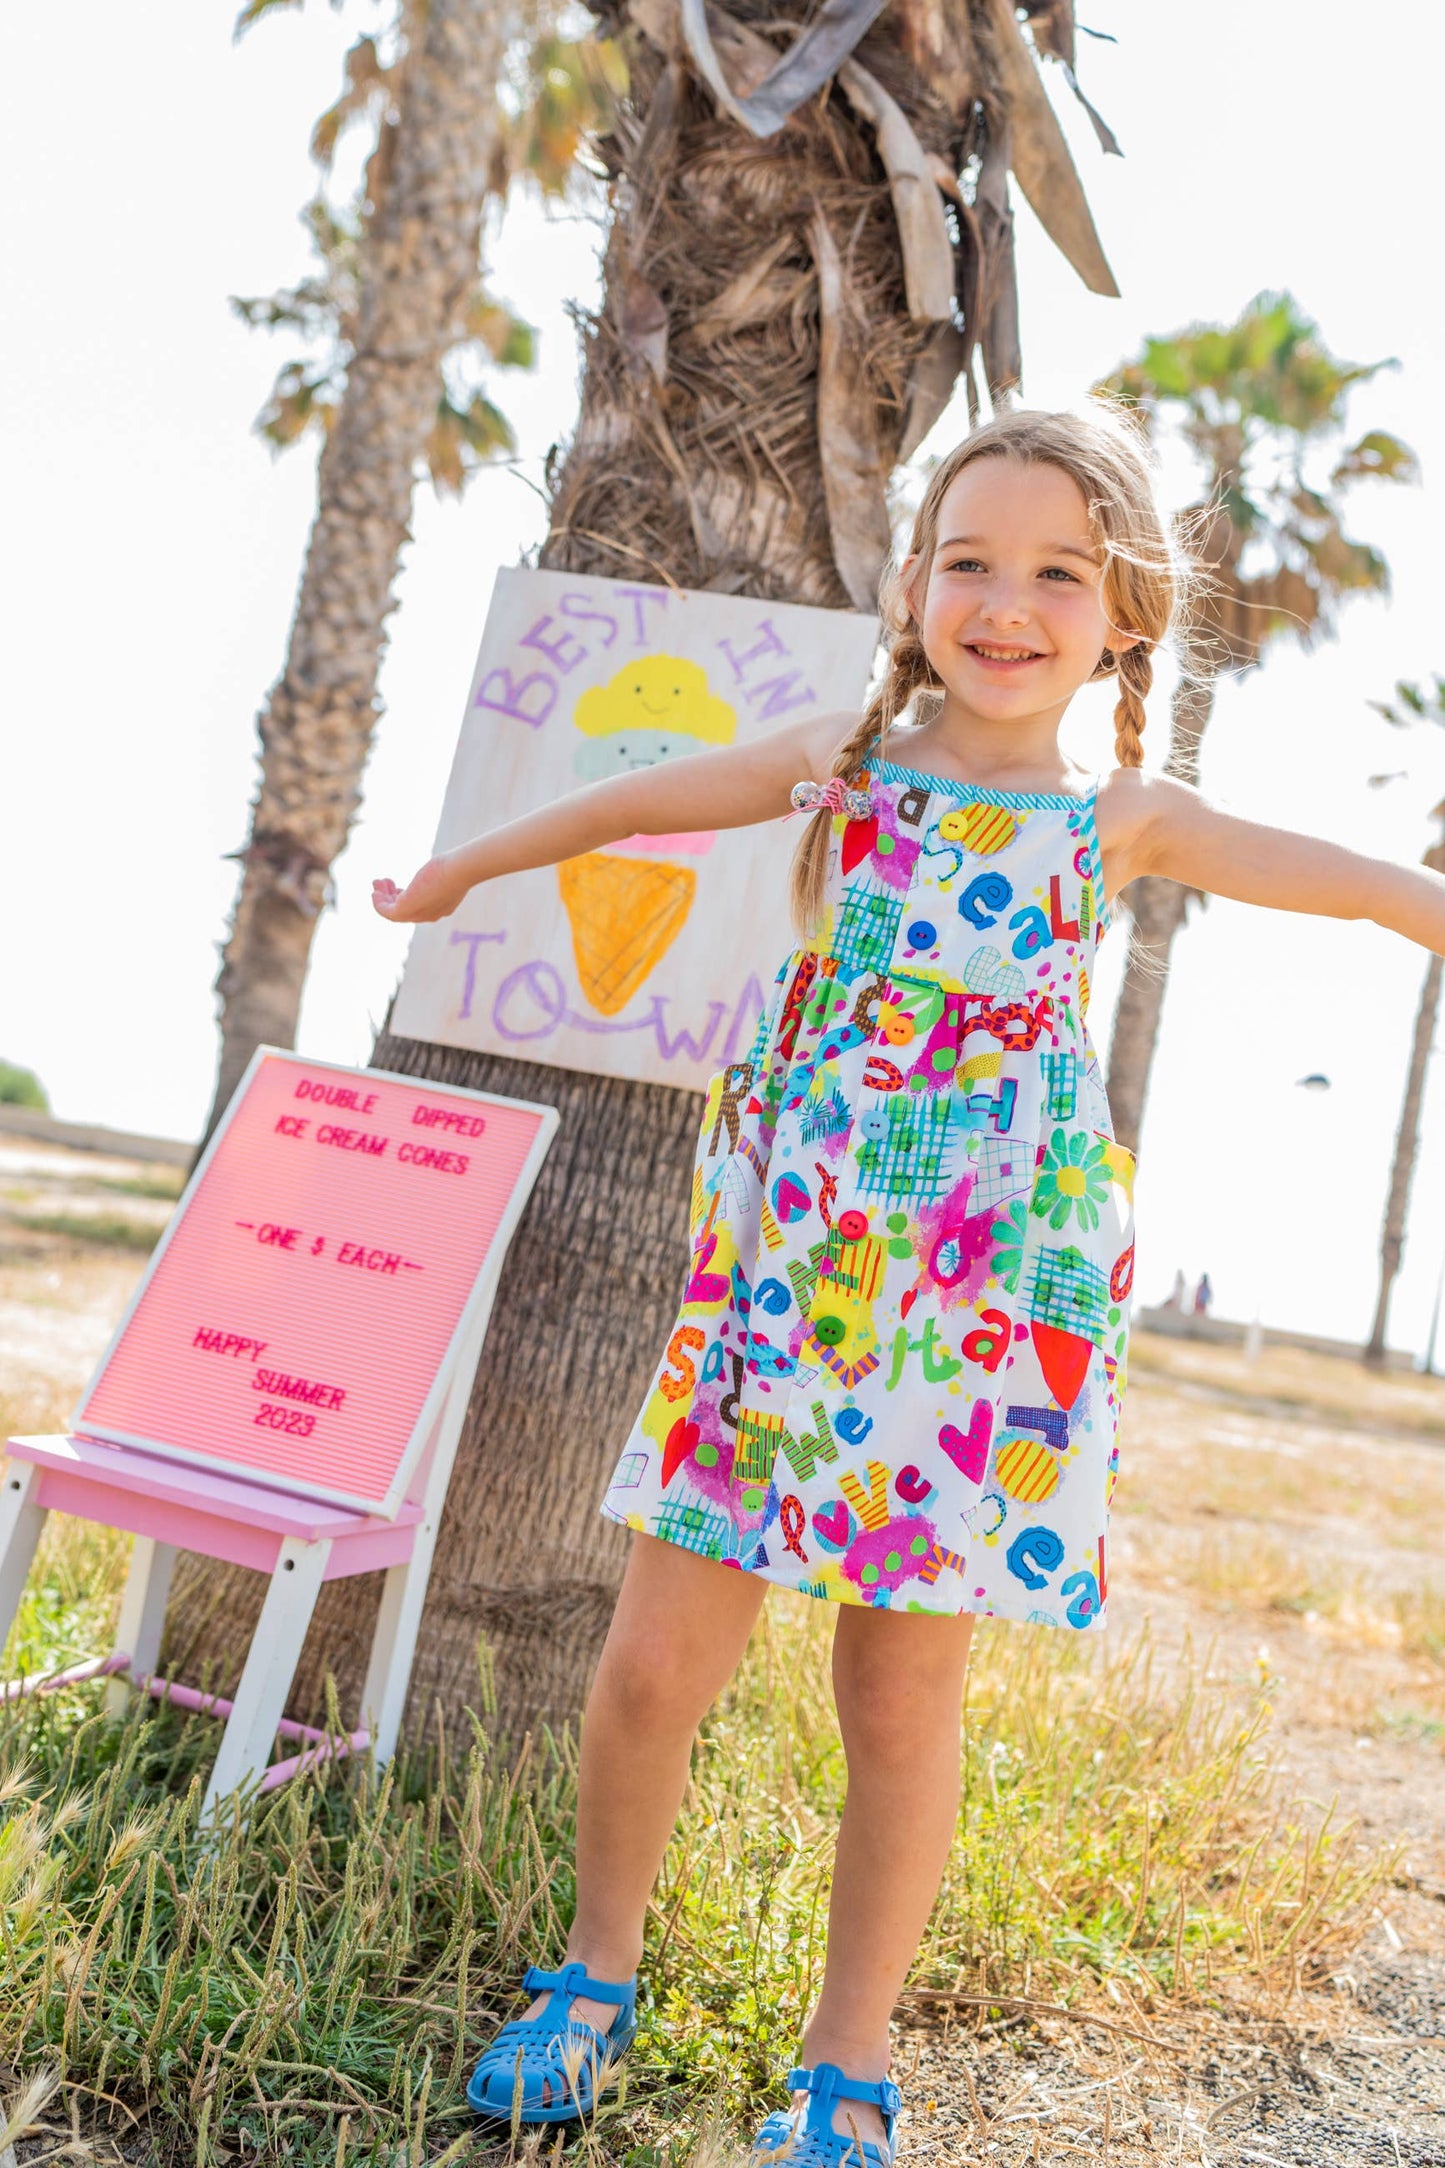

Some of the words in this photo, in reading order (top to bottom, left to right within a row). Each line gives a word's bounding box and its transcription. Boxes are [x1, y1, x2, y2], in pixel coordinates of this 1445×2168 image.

[474, 587, 669, 730] BEST
[716, 618, 817, 722] IN
[294, 1079, 379, 1115] DOUBLE
[411, 1104, 486, 1138] DIPPED
[274, 1114, 311, 1139] ICE
[316, 1123, 390, 1157] CREAM
[397, 1142, 470, 1175] CONES
[192, 1325, 269, 1363] HAPPY
[251, 1368, 346, 1412] SUMMER
[253, 1402, 317, 1438] 2023
